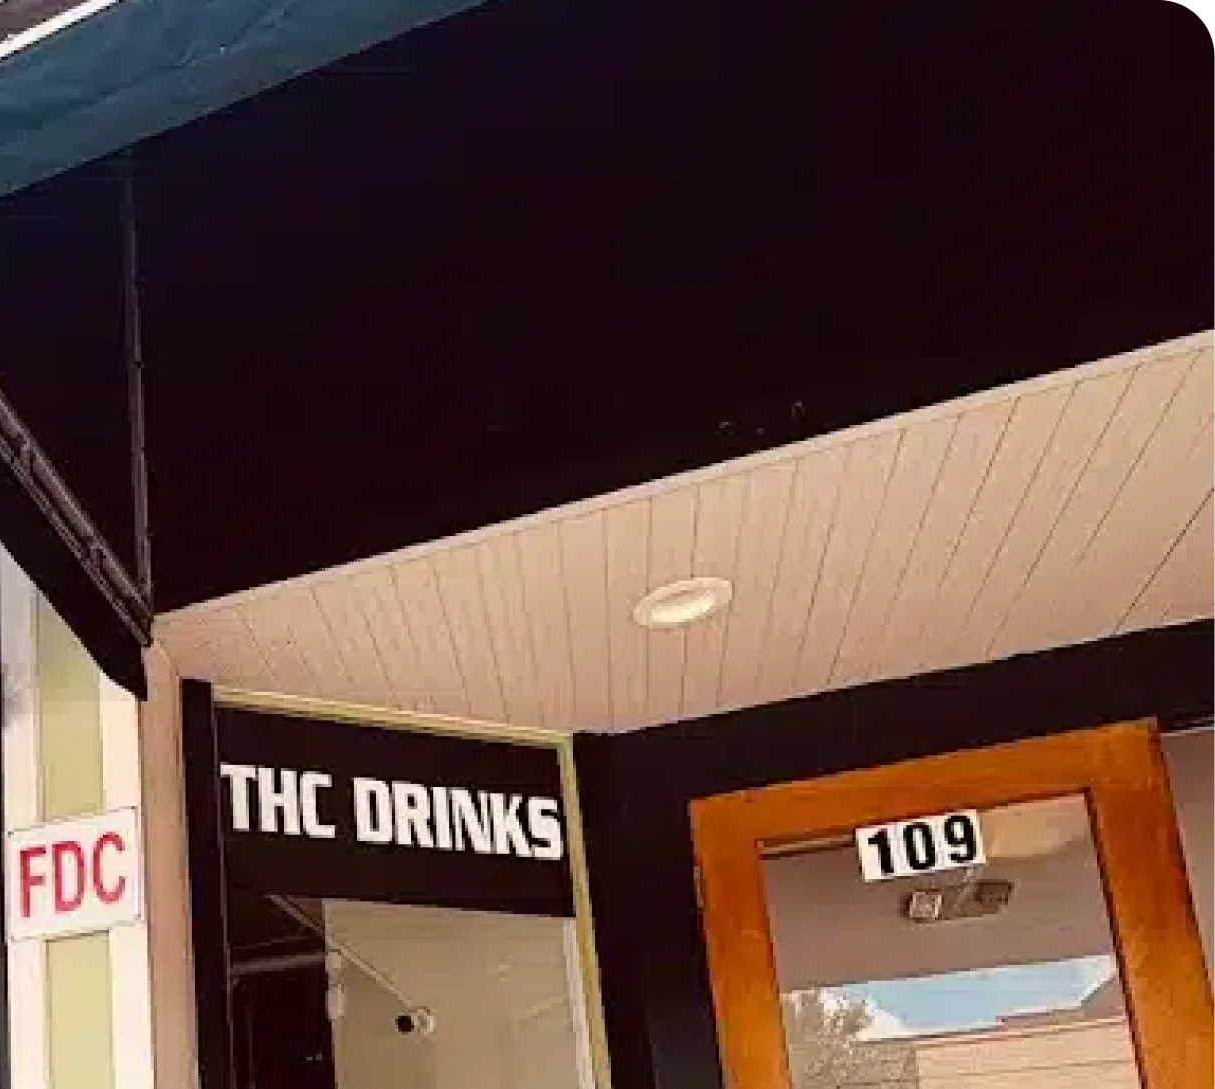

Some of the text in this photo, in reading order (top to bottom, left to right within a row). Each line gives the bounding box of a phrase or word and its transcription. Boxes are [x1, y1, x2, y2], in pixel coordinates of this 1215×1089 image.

[220, 762, 566, 861] THC DRINKS
[866, 814, 979, 878] 109
[19, 831, 127, 919] FDC
